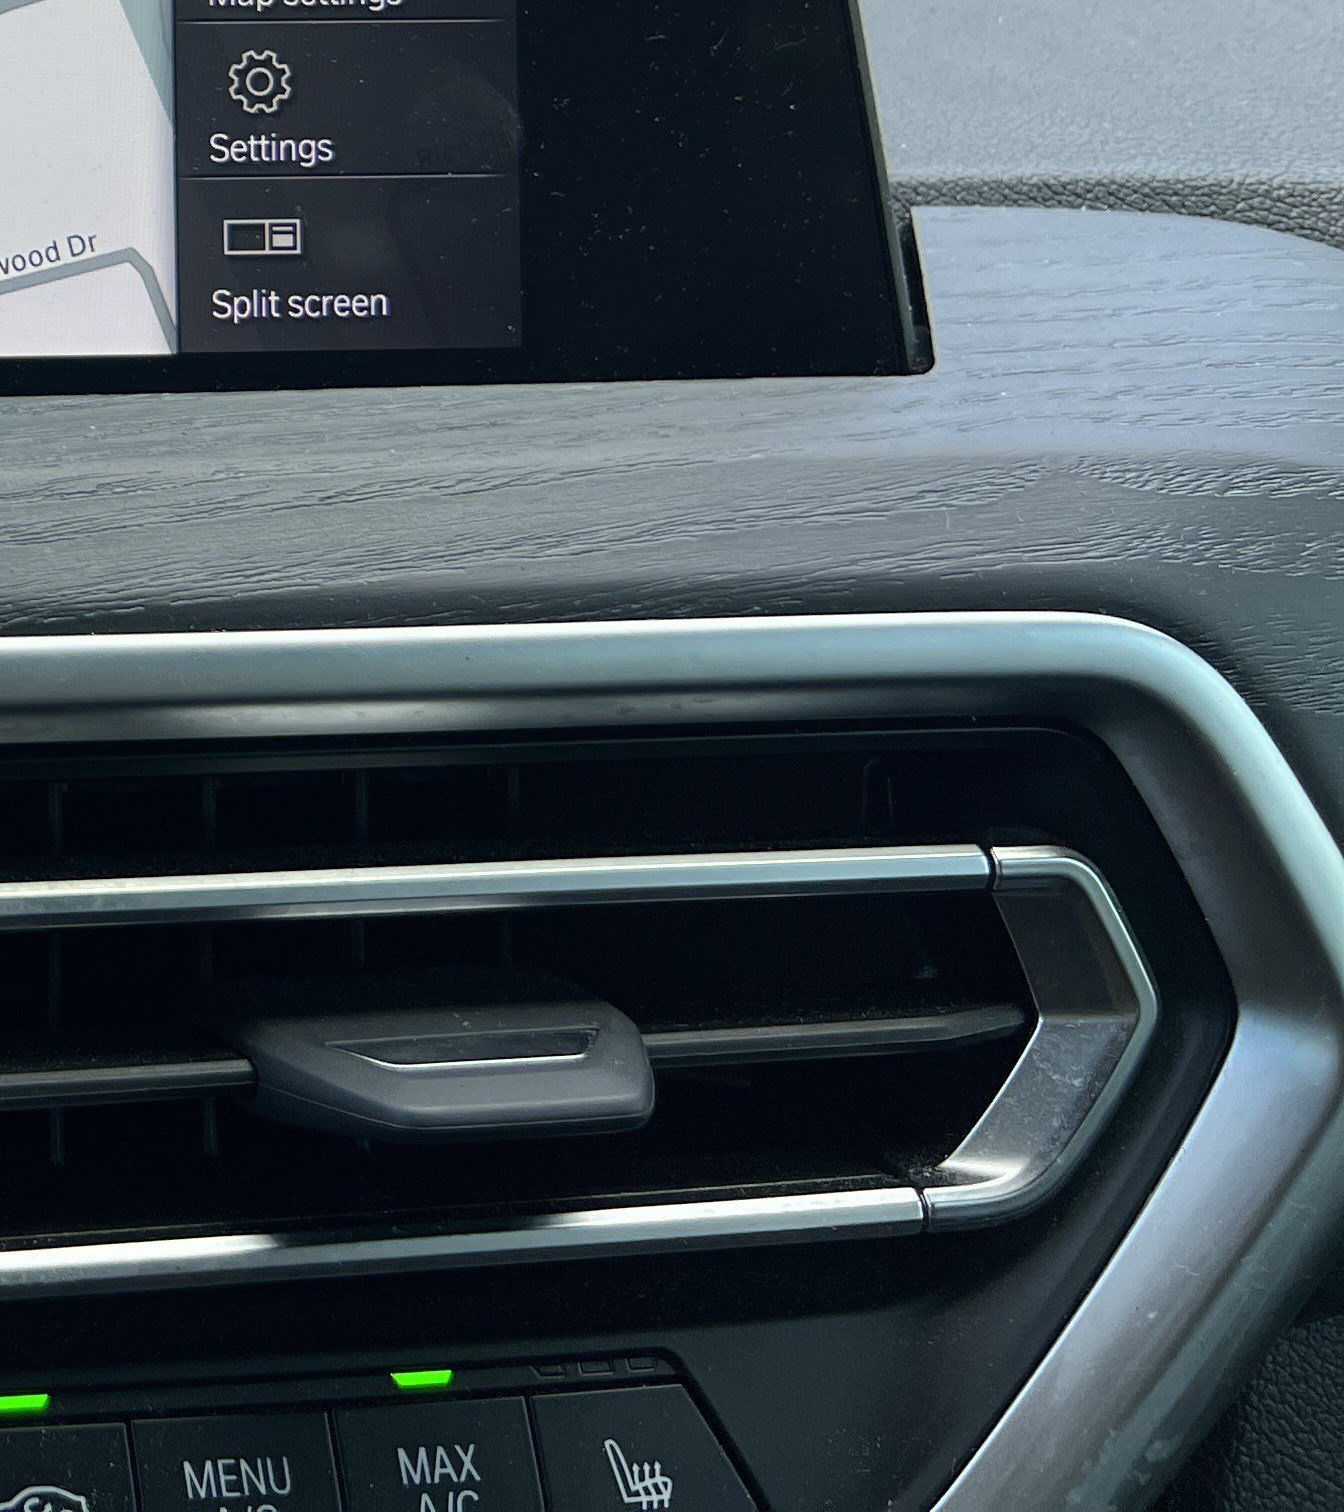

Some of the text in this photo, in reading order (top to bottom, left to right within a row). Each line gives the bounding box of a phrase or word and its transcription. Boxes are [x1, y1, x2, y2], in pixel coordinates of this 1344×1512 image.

[209, 133, 335, 168] Settings
[66, 233, 98, 258] Dr
[212, 289, 389, 324] Split screen
[182, 1455, 292, 1500] MENU
[396, 1443, 482, 1486] MAX
